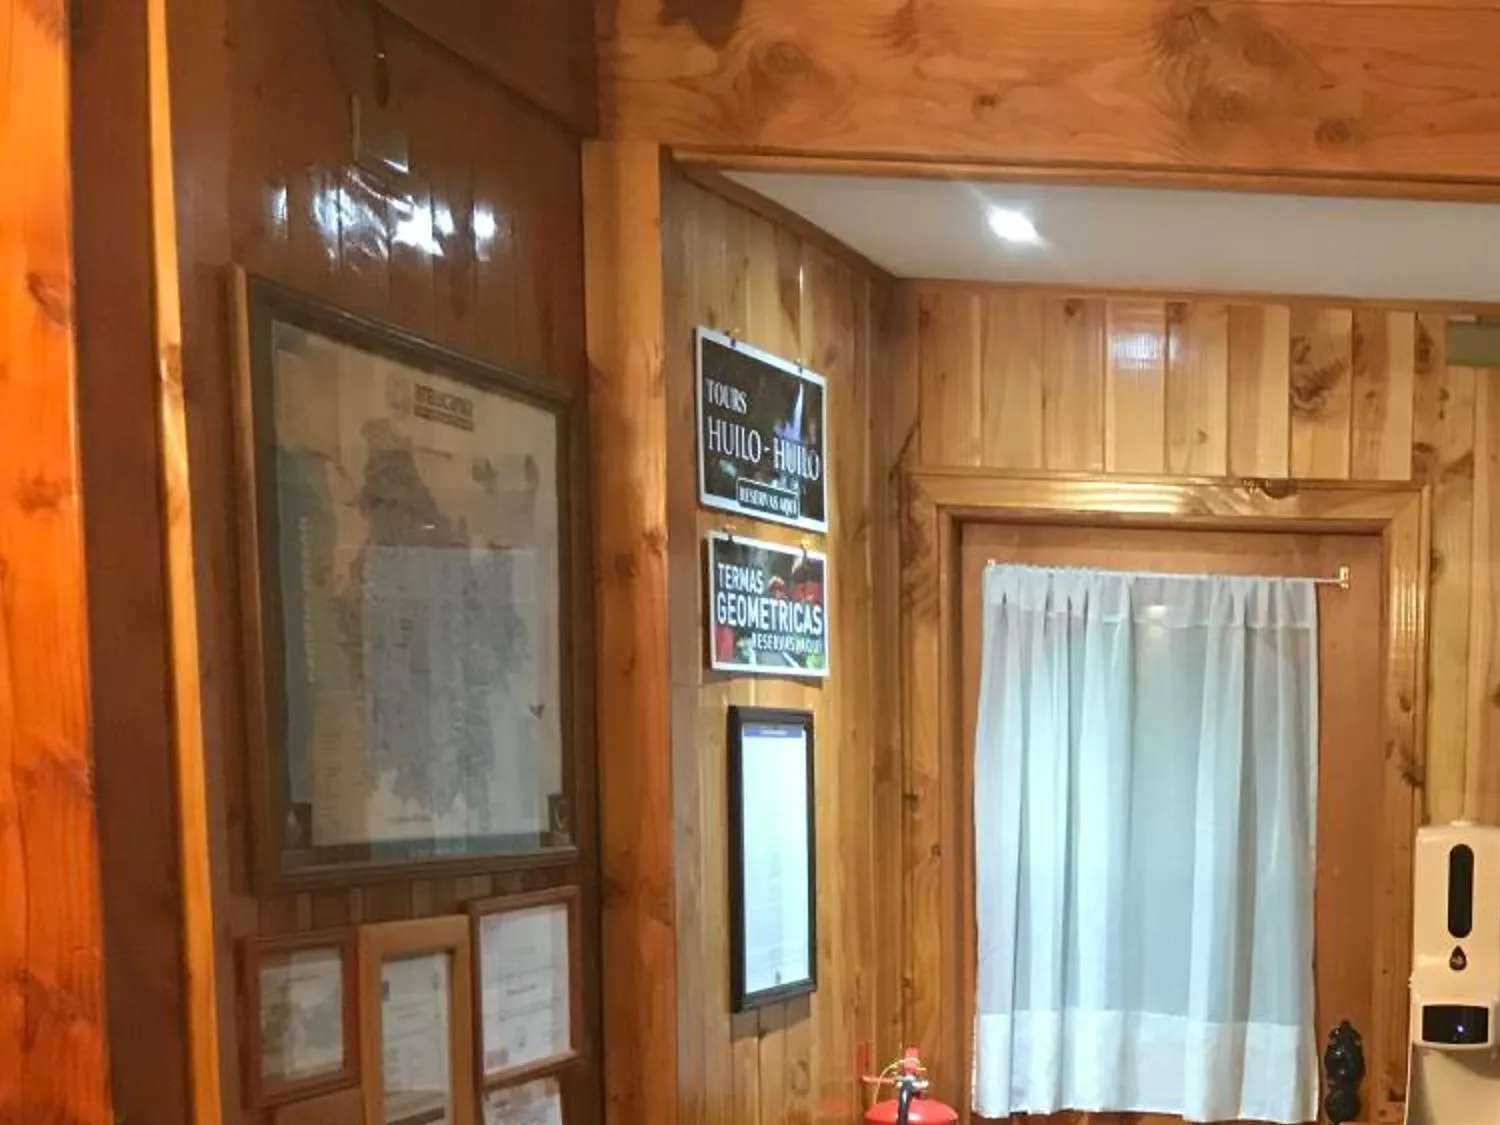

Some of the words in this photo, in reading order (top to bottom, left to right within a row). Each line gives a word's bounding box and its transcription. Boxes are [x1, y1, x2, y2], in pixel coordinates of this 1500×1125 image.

[706, 379, 747, 415] TOURS
[707, 415, 761, 463] HUILO
[773, 436, 819, 481] HUILO
[718, 563, 764, 595] TERMAS
[717, 591, 823, 636] GEOMETRICAS
